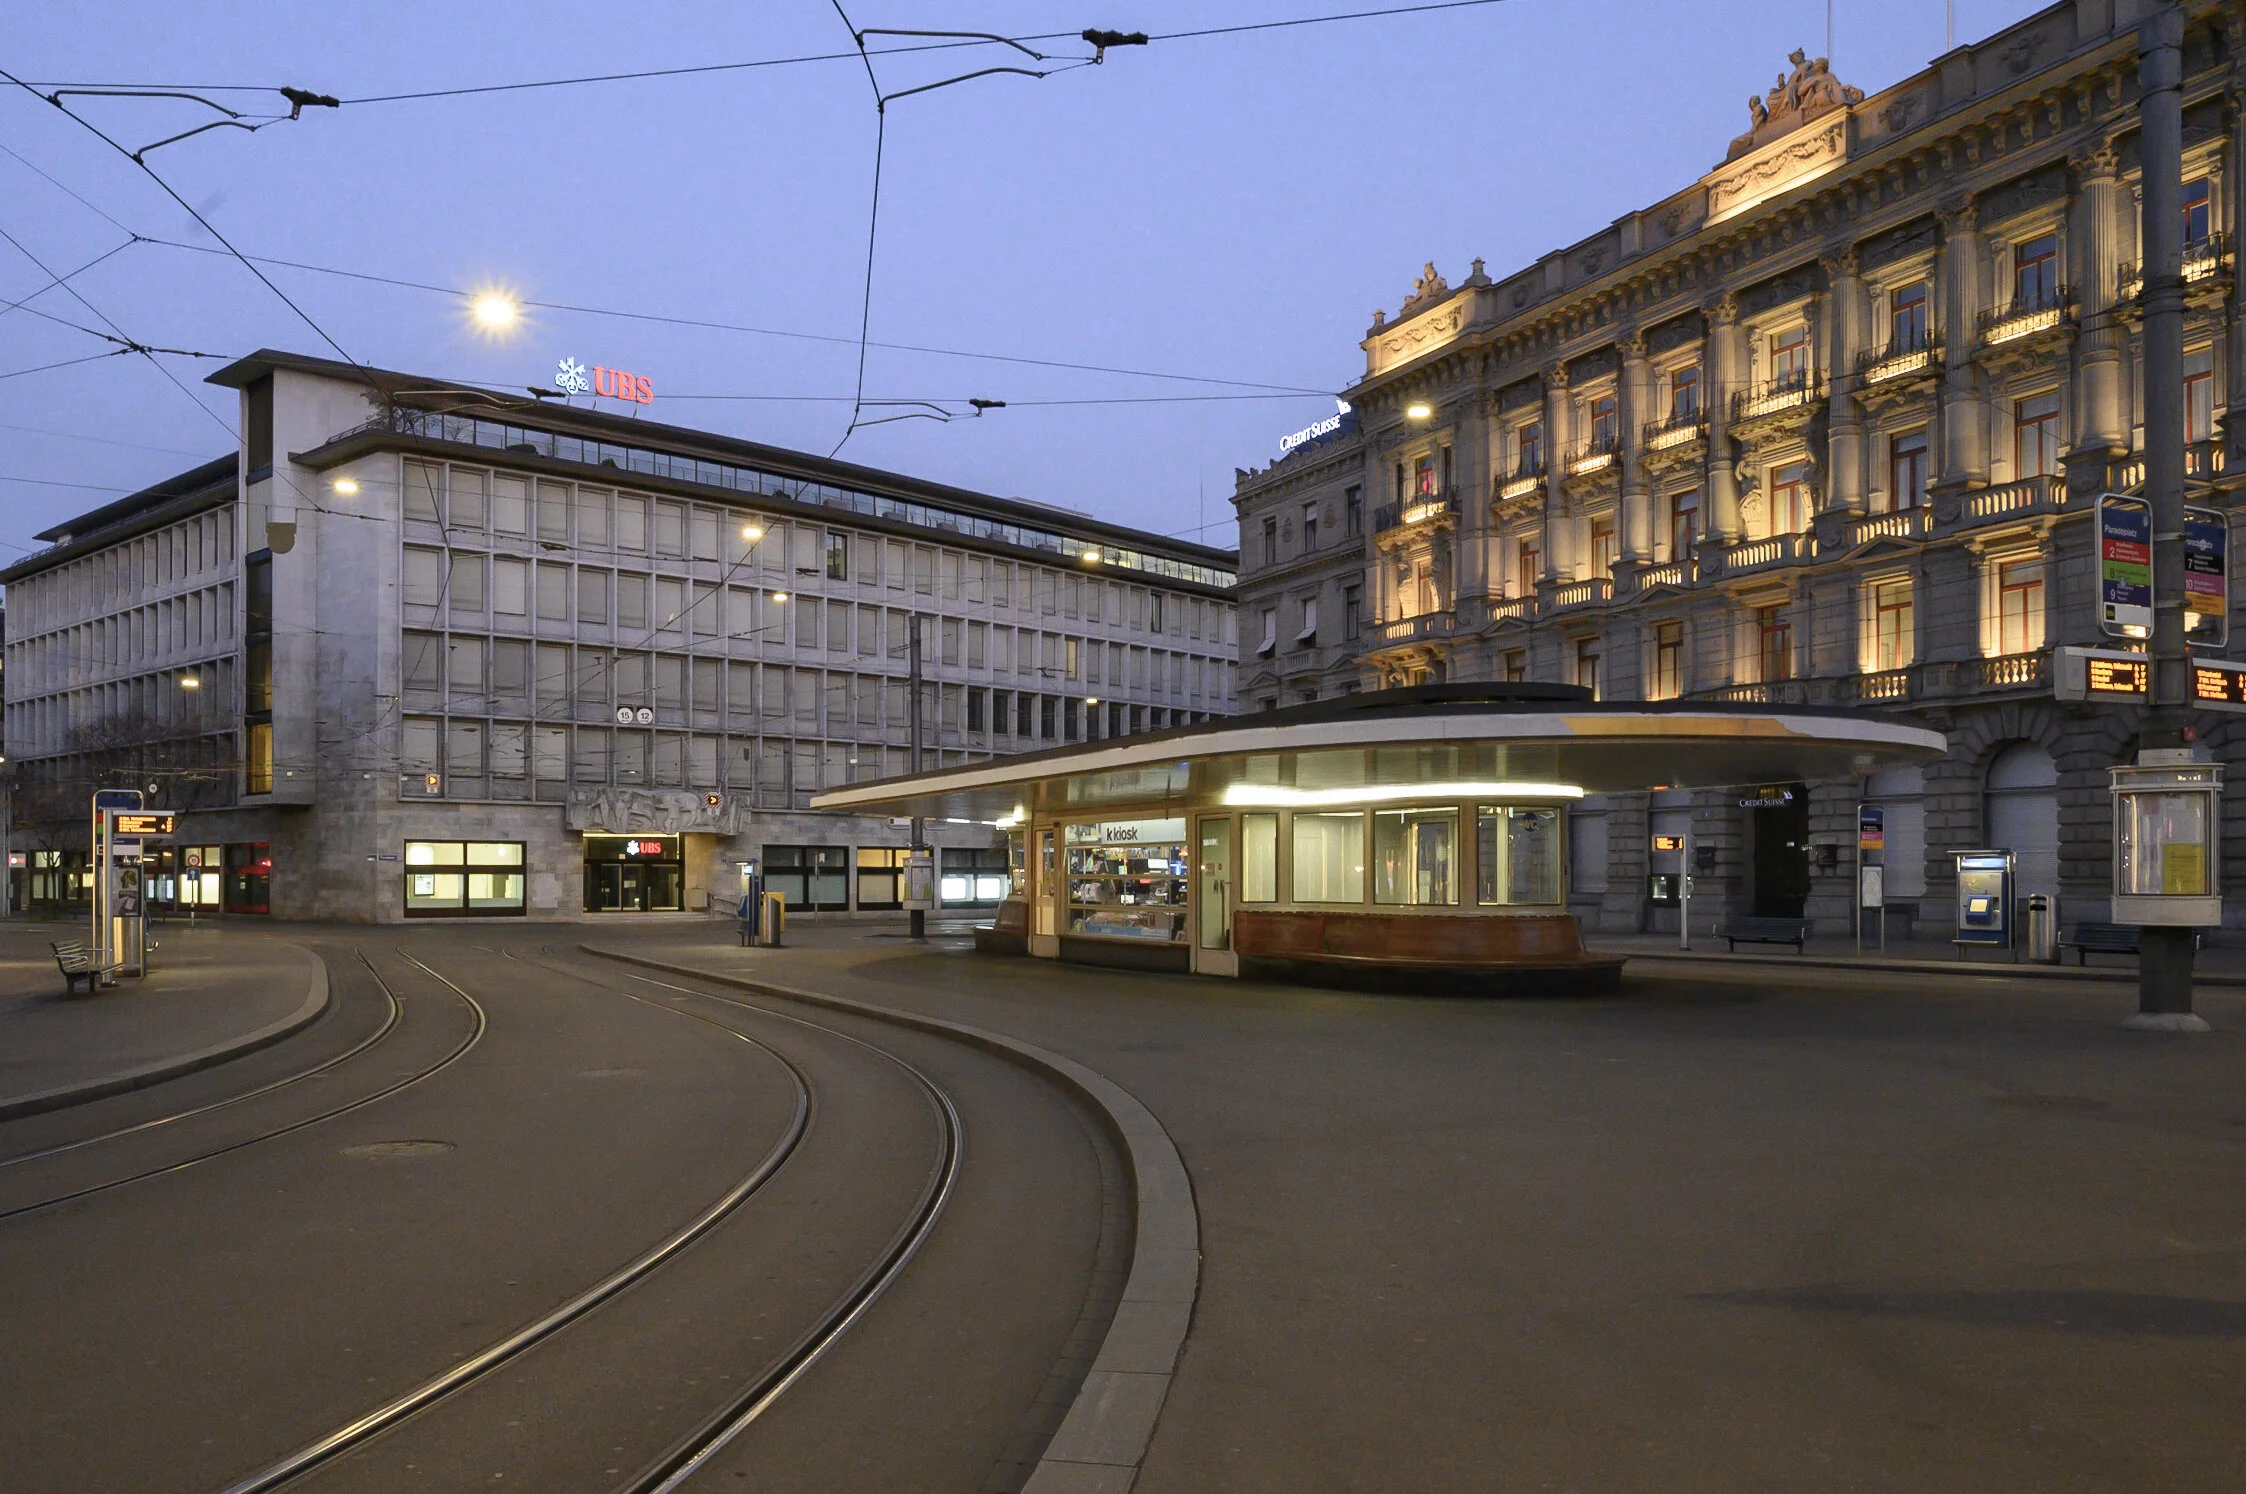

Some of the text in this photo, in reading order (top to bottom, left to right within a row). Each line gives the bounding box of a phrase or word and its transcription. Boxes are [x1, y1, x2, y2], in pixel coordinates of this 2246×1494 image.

[593, 366, 654, 404] UBS
[1279, 415, 1341, 451] CREDIT SUISSE
[2109, 547, 2115, 558] 2
[2187, 558, 2193, 569] 7
[2185, 578, 2193, 590] 10
[2110, 588, 2116, 600] 9
[641, 712, 650, 720] 12
[1739, 798, 1785, 807] CREDIT SUISSE
[1106, 825, 1138, 841] k kiosk
[640, 841, 662, 854] UBS
